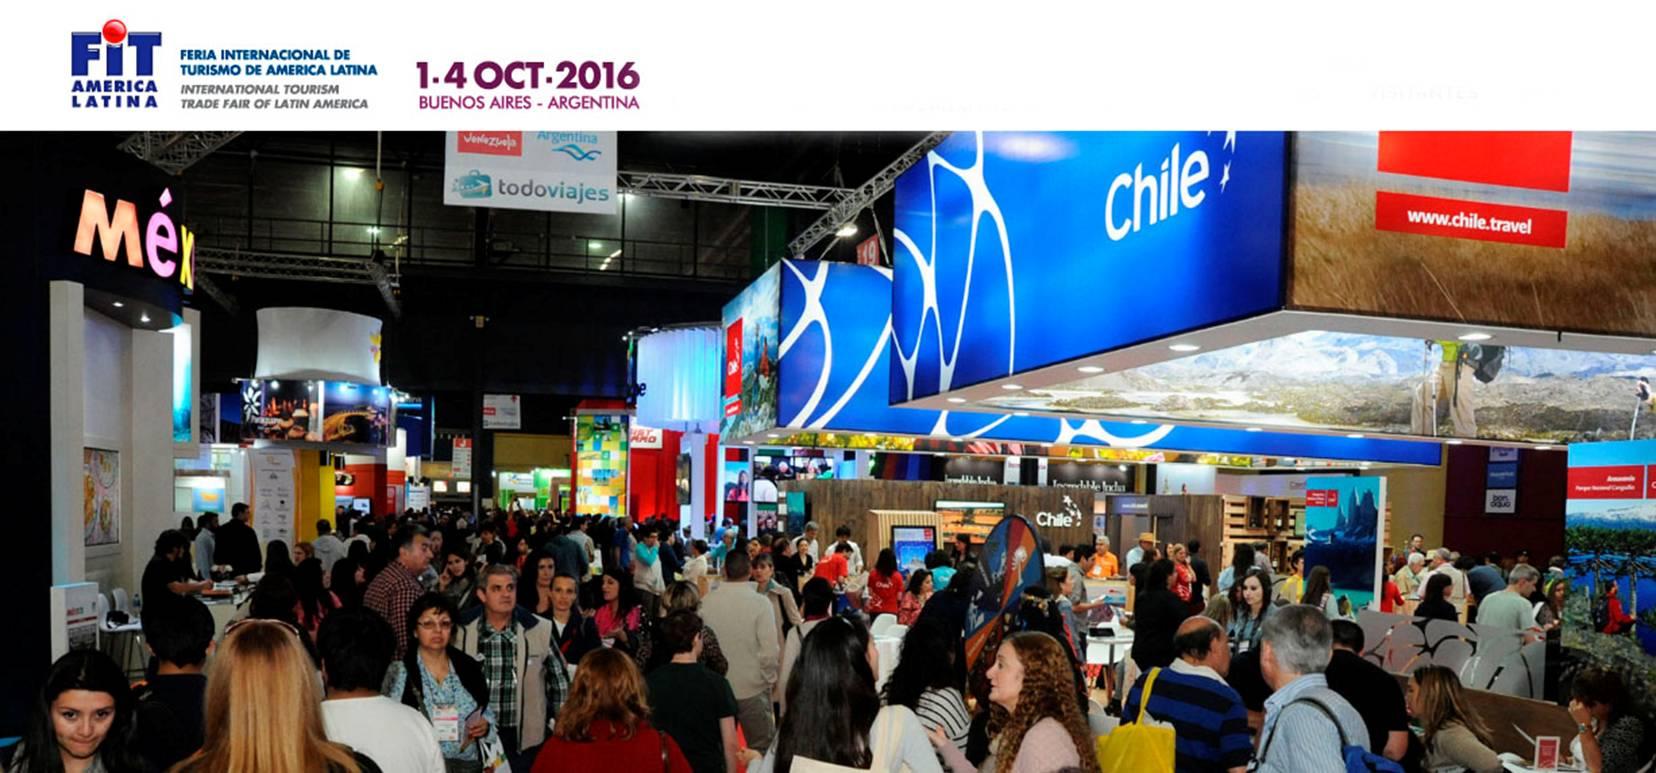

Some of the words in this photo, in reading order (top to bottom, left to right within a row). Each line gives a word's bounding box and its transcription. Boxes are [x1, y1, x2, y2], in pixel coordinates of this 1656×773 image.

[498, 179, 610, 204] todoviajes
[1105, 142, 1209, 241] Chile
[1407, 210, 1533, 235] www.chile.travel
[1036, 511, 1073, 527] Chile
